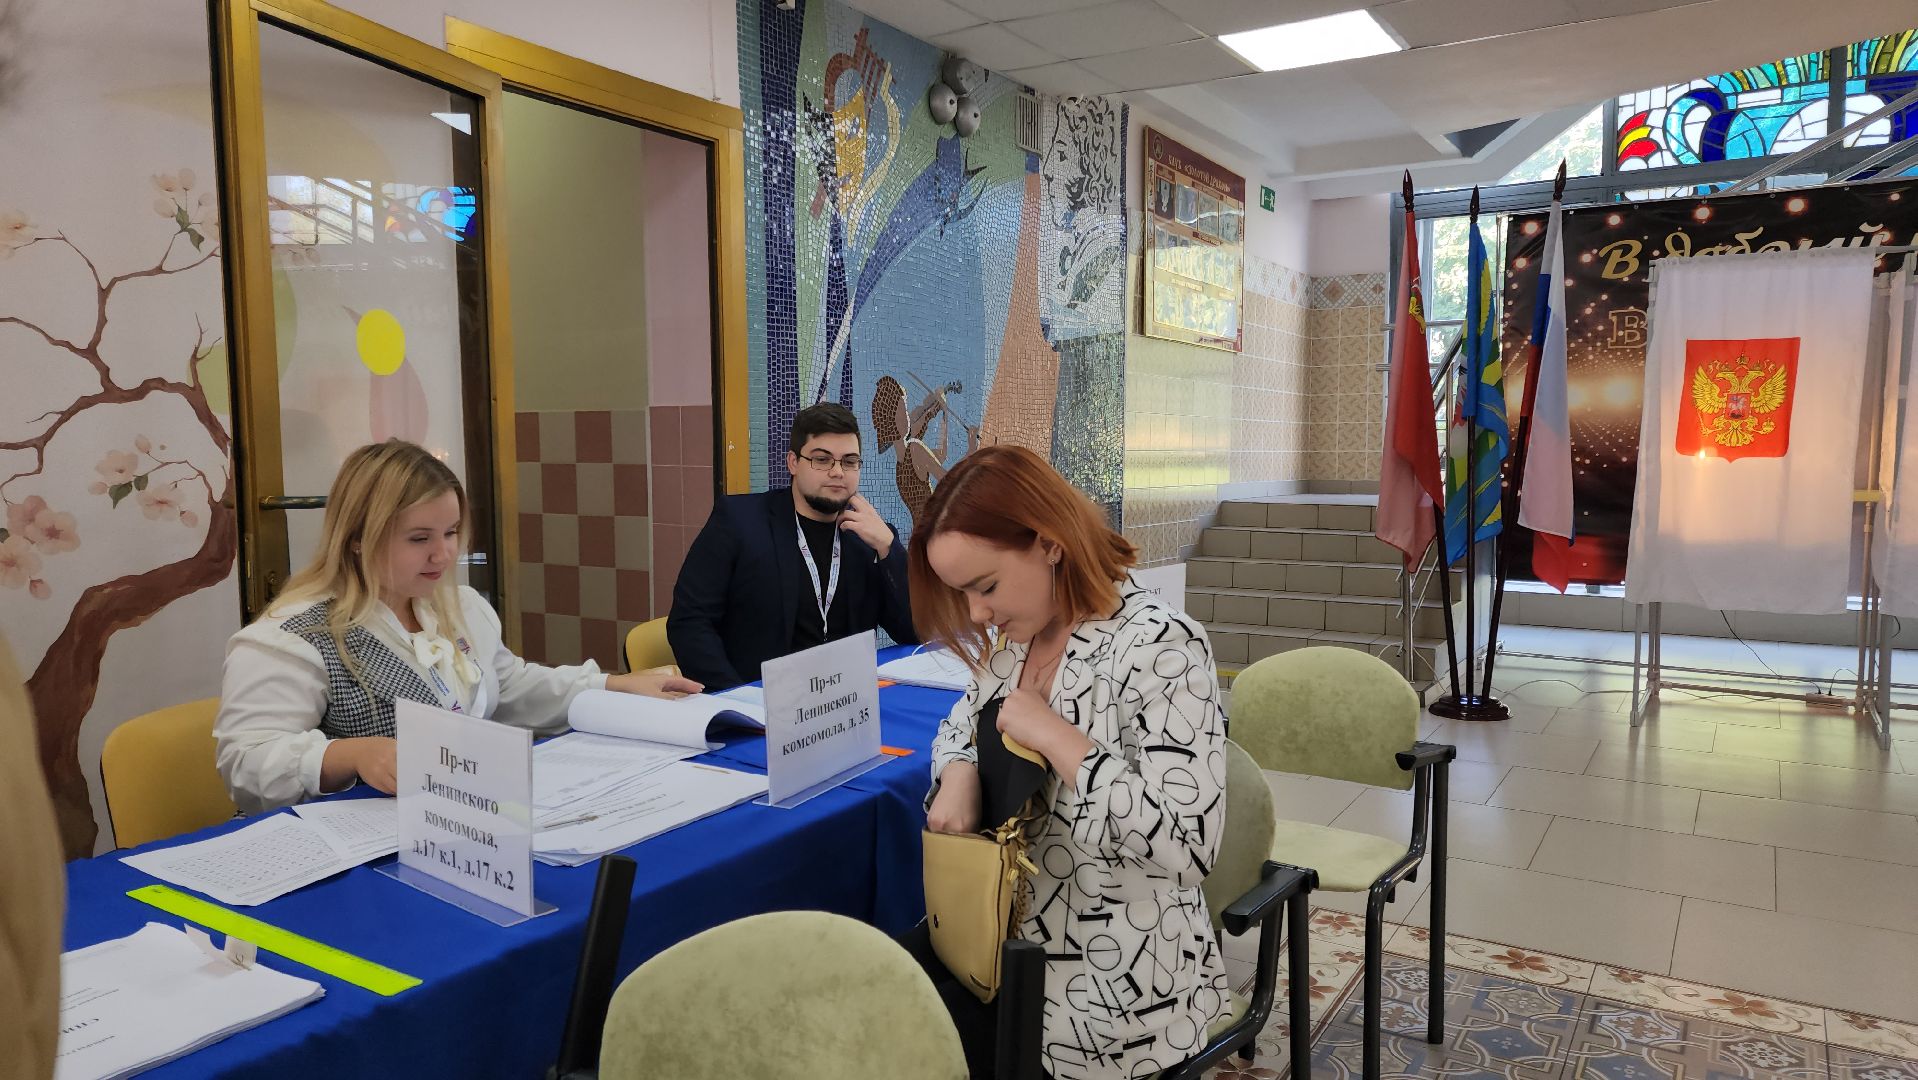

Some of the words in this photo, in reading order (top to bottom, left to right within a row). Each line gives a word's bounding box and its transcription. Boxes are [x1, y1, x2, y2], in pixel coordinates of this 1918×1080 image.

[1600, 239, 1643, 279] В
[809, 672, 842, 694] Пр-кт
[794, 691, 858, 725] Ленинского
[782, 722, 846, 756] комсомола,
[848, 717, 857, 731] д.
[858, 707, 870, 725] 35
[440, 746, 478, 775] Пр-кт
[422, 773, 499, 815] Ленинского
[424, 810, 498, 852] комсомола,
[413, 839, 436, 859] д.17
[439, 849, 461, 873] к.1,
[464, 859, 490, 880] д.17
[494, 870, 515, 891] к.2
